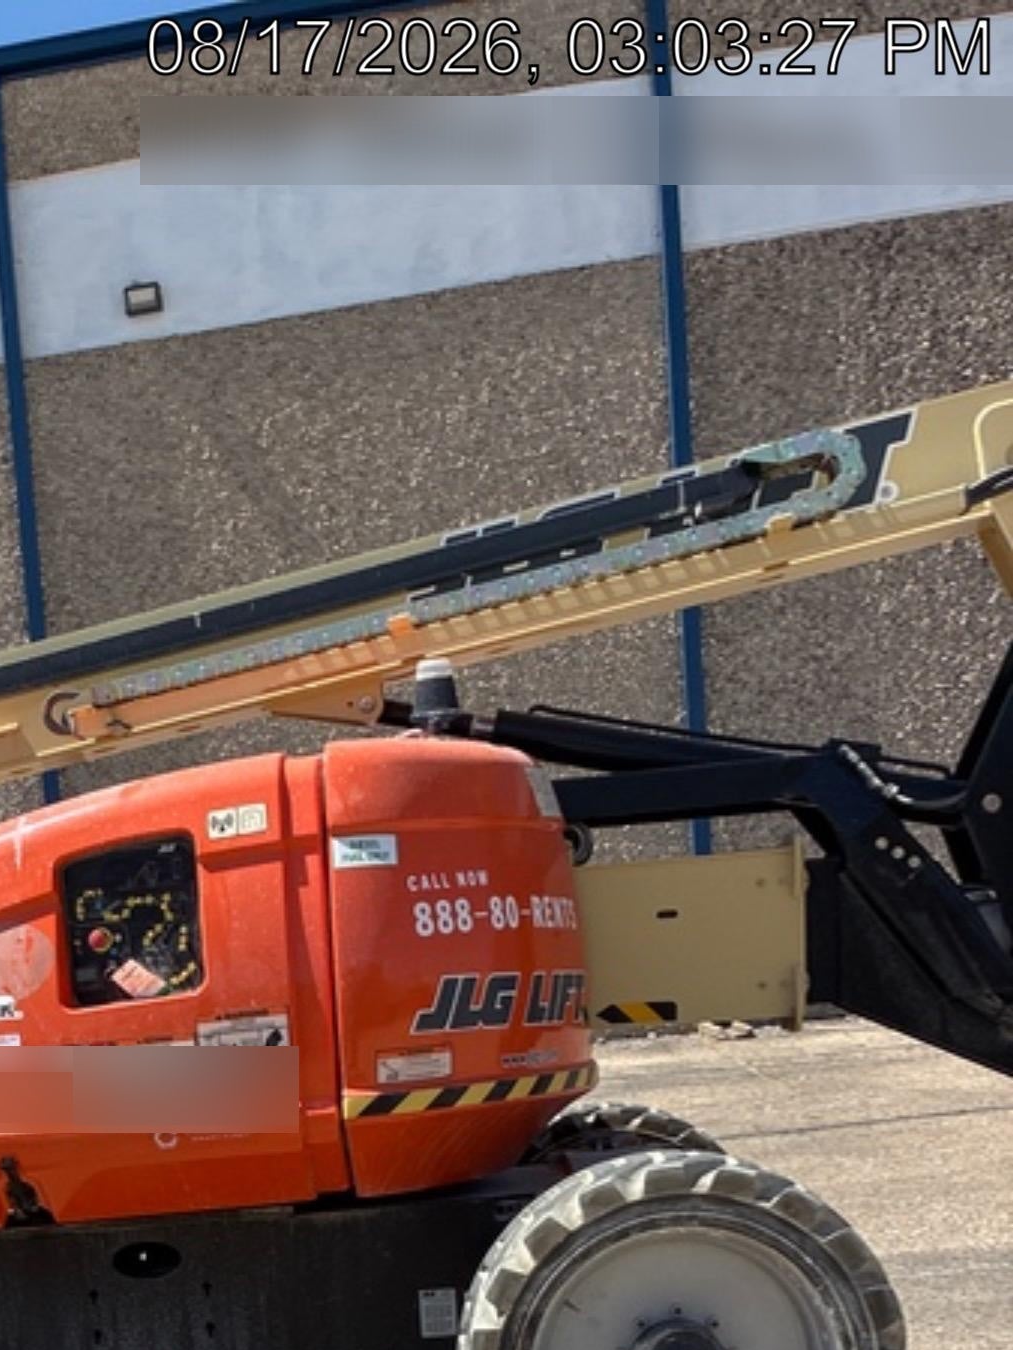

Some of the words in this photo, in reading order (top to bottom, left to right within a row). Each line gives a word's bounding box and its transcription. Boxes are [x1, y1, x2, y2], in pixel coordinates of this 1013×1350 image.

[406, 873, 452, 892] CALL
[457, 869, 489, 888] NOW
[413, 895, 578, 938] 888-80-RENTS
[409, 971, 522, 1036] JLG
